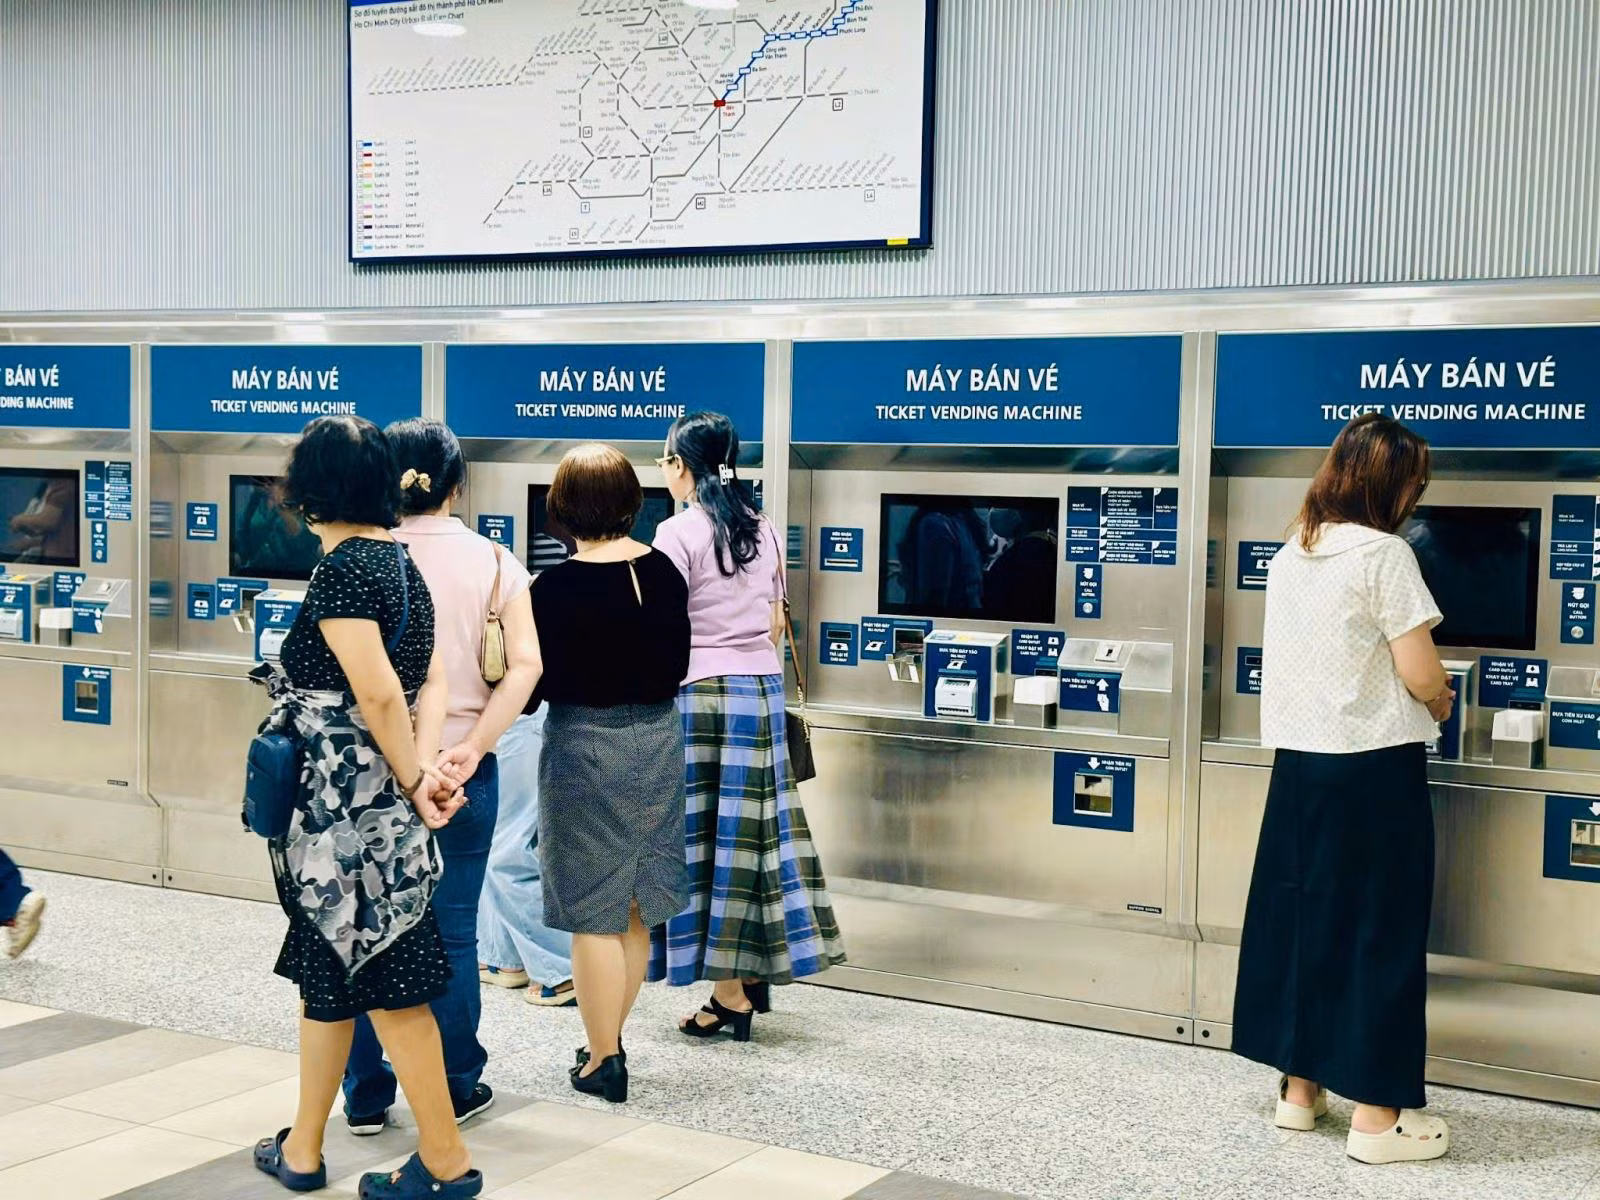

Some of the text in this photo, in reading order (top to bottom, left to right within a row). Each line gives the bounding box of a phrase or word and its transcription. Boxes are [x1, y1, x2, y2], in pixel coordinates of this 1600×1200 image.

[5, 364, 59, 387] BÁN VÉ
[232, 366, 339, 390] MÁY BÁN VÉ
[540, 366, 666, 392] MÁY BÁN VÉ
[906, 364, 1058, 392] MÁY BÁN VÉ
[1360, 356, 1556, 388] MÁY BÁN VÉ
[0, 396, 74, 409] DING MACHINE
[210, 400, 356, 414] TICKET VENDING MACHINE
[515, 404, 686, 418] TICKET VENDING MACHINE
[1321, 404, 1586, 420] TICKET VENDING MACHINE
[876, 405, 1082, 420] TICKET VENDING MACHINE
